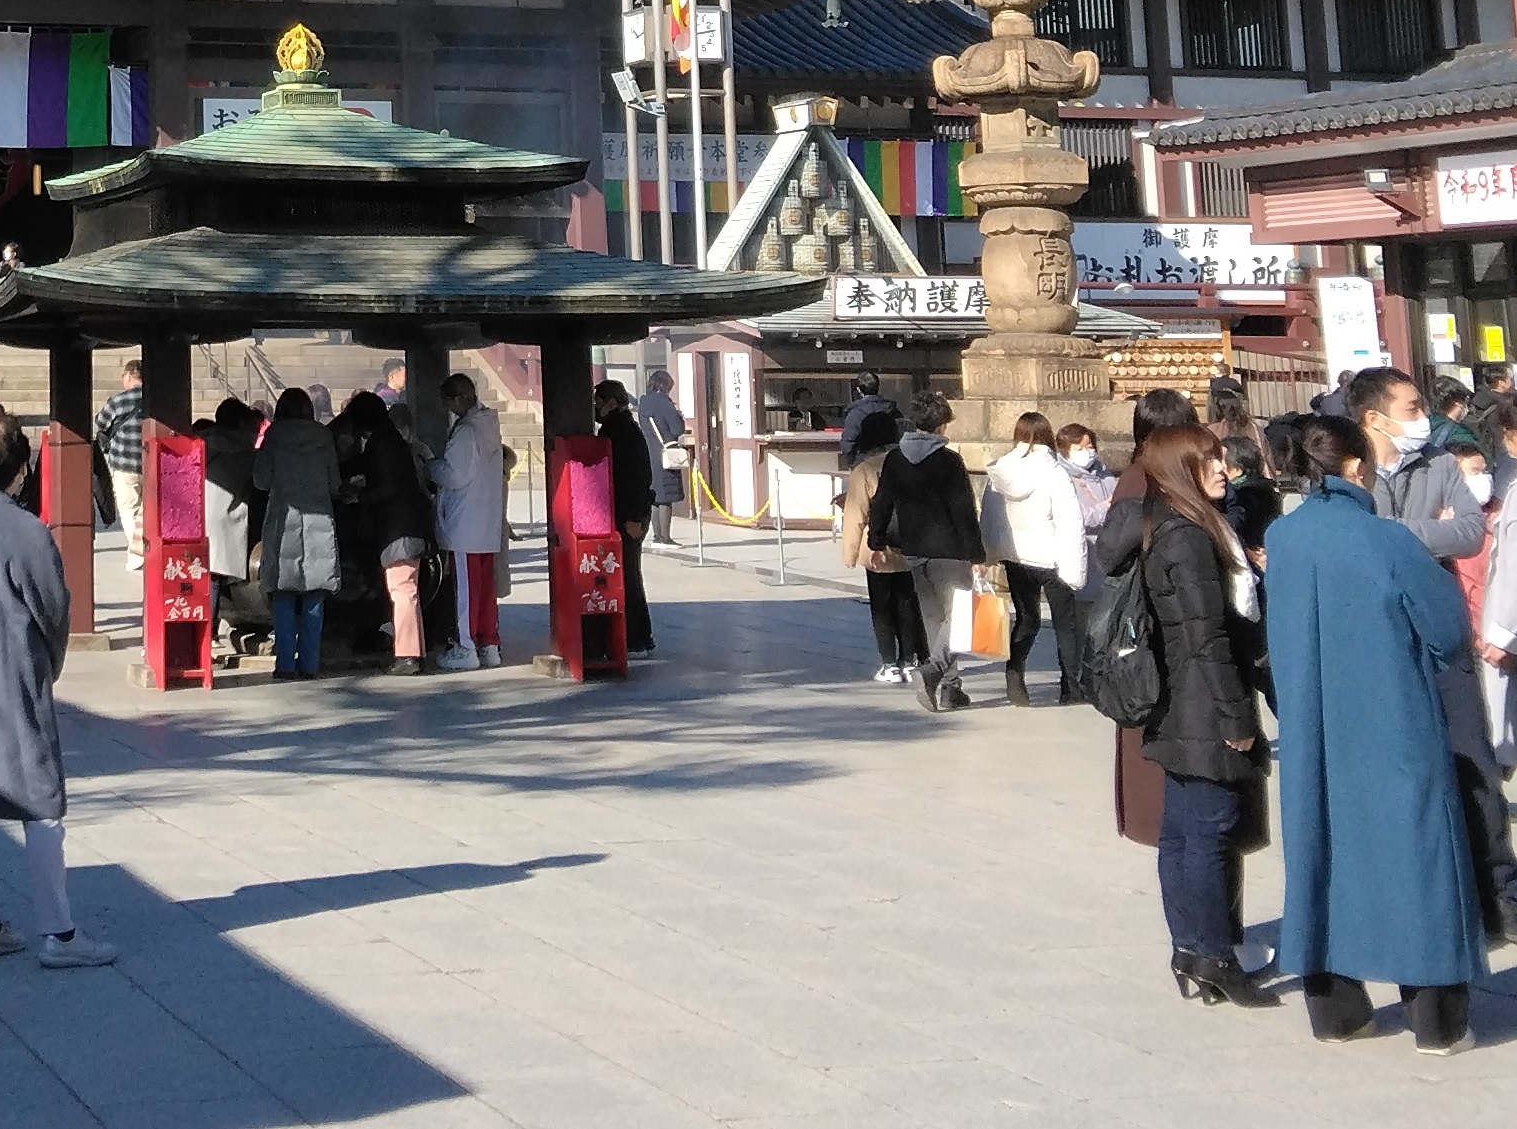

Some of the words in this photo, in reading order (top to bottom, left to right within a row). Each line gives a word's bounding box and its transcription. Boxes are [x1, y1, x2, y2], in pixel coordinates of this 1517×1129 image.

[1142, 227, 1219, 249] 御護摩
[1033, 237, 1069, 301] 長明
[1083, 254, 1282, 285] お札お渡し所
[846, 280, 991, 314] 奉納護摩
[163, 556, 209, 581] 献香
[579, 551, 621, 574] 献香
